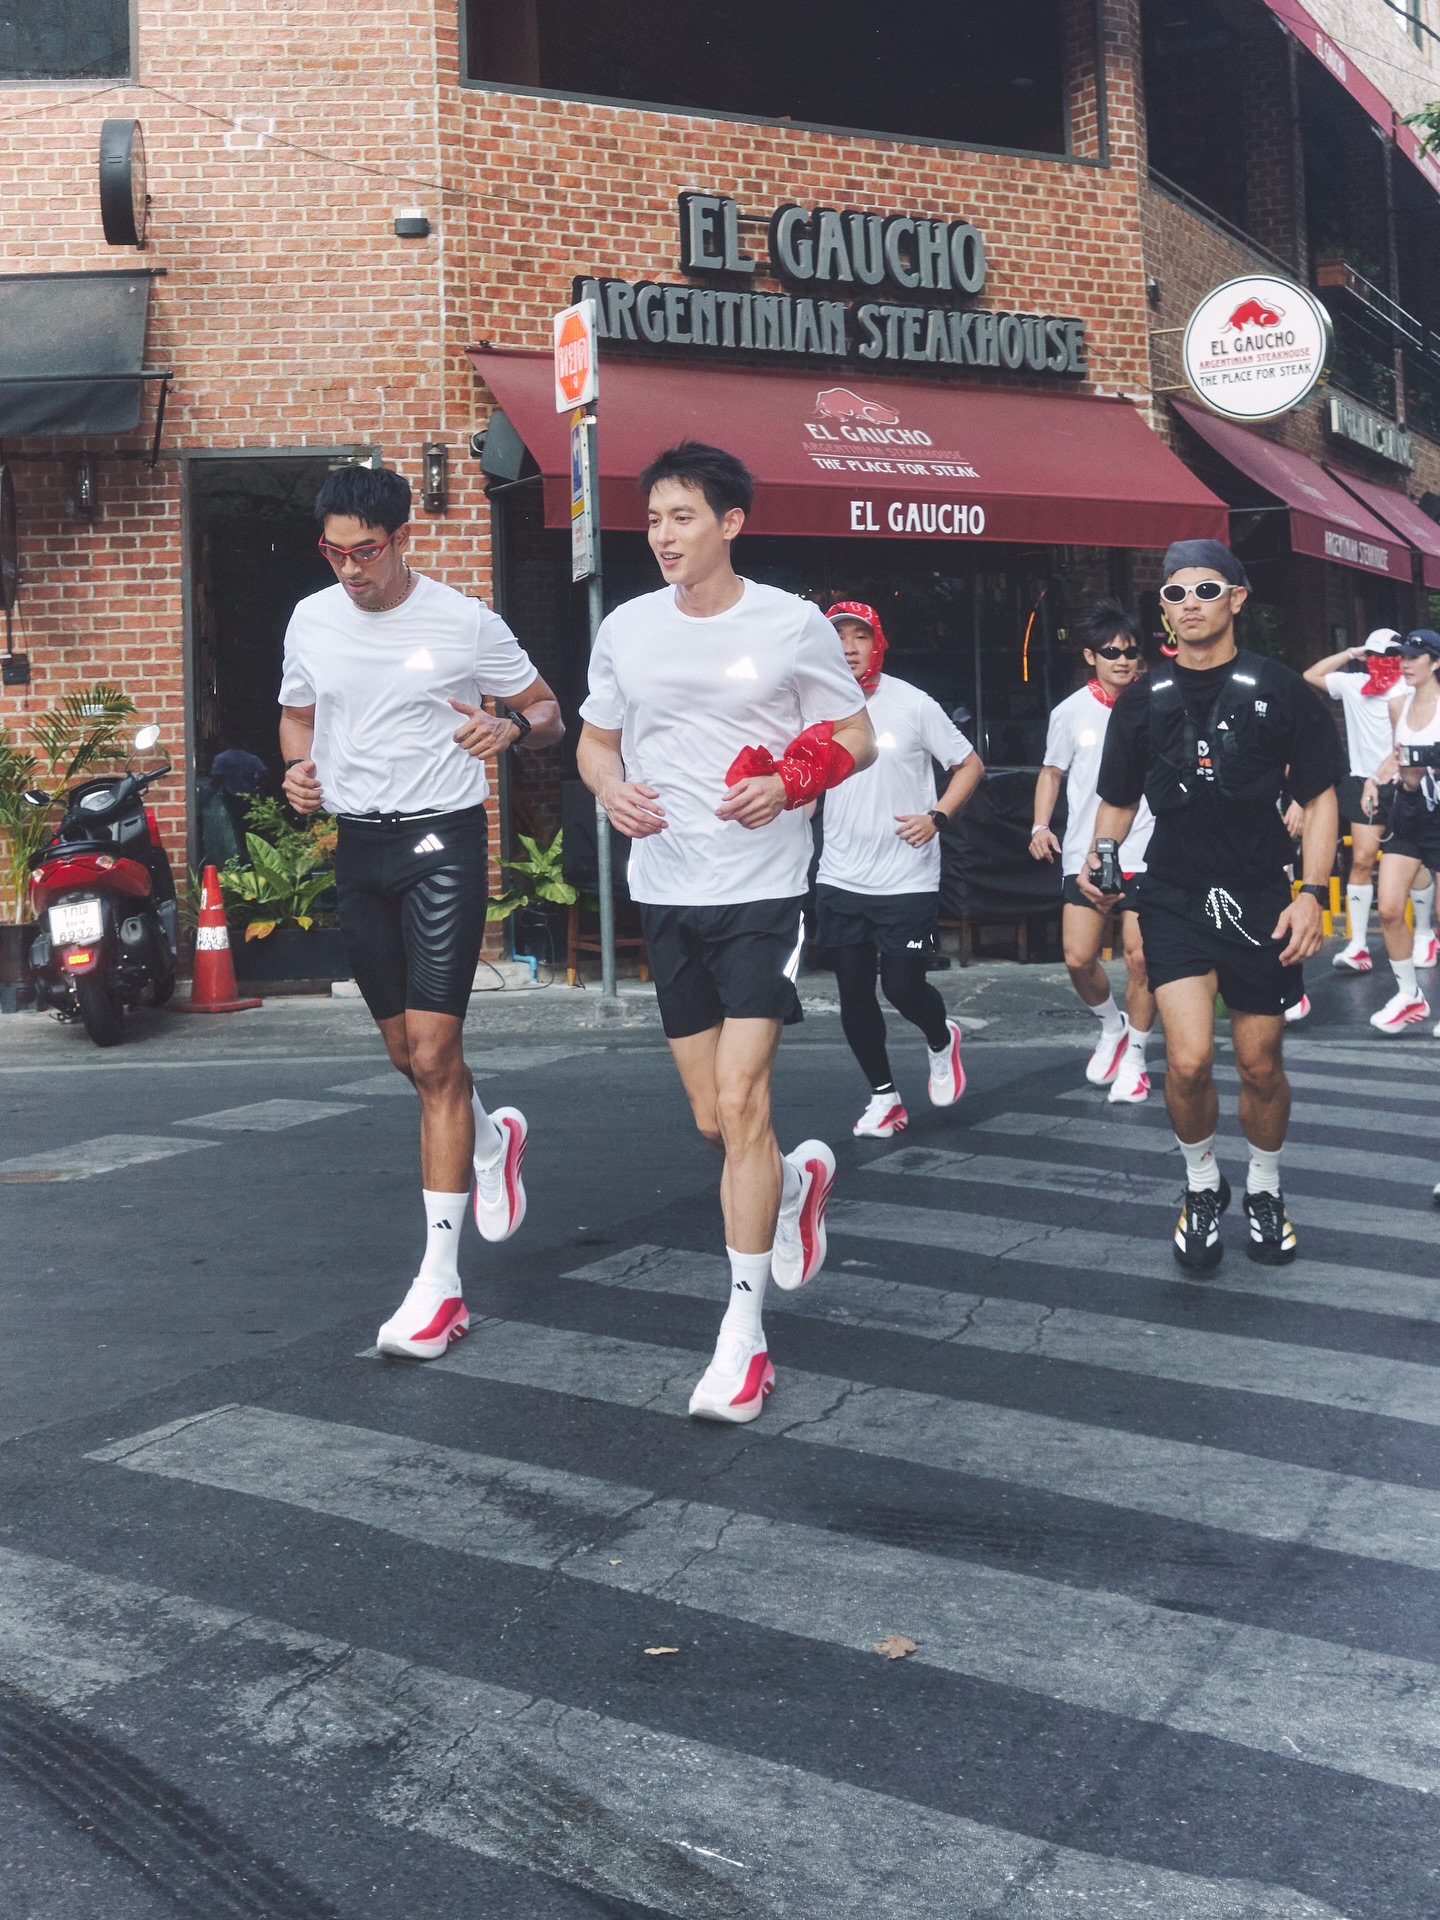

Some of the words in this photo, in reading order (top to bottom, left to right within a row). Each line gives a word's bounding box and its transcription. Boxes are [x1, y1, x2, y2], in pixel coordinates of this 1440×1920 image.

[684, 193, 756, 274] EL
[774, 203, 987, 294] GAUCHO
[580, 279, 847, 356] ARGENTINIAN
[857, 303, 1088, 373] STEAKHOUSE
[1211, 340, 1230, 356] EL
[1233, 330, 1295, 352] GAUCHO
[558, 337, 588, 389] หยุด
[1199, 355, 1254, 370] ARGENTINIAN
[1256, 347, 1311, 363] STEAKHOUSE
[1200, 375, 1218, 387] THE
[1221, 371, 1252, 384] PLACE
[1256, 367, 1275, 380] FOR
[1279, 363, 1312, 377] STEAK
[804, 423, 839, 441] EL
[840, 425, 933, 446] GAUCHO
[812, 457, 846, 470] THE
[847, 460, 897, 474] PLACE
[897, 463, 931, 476] FOR
[931, 465, 981, 478] STEAK
[850, 501, 880, 531] EL
[888, 502, 985, 534] GAUCHO
